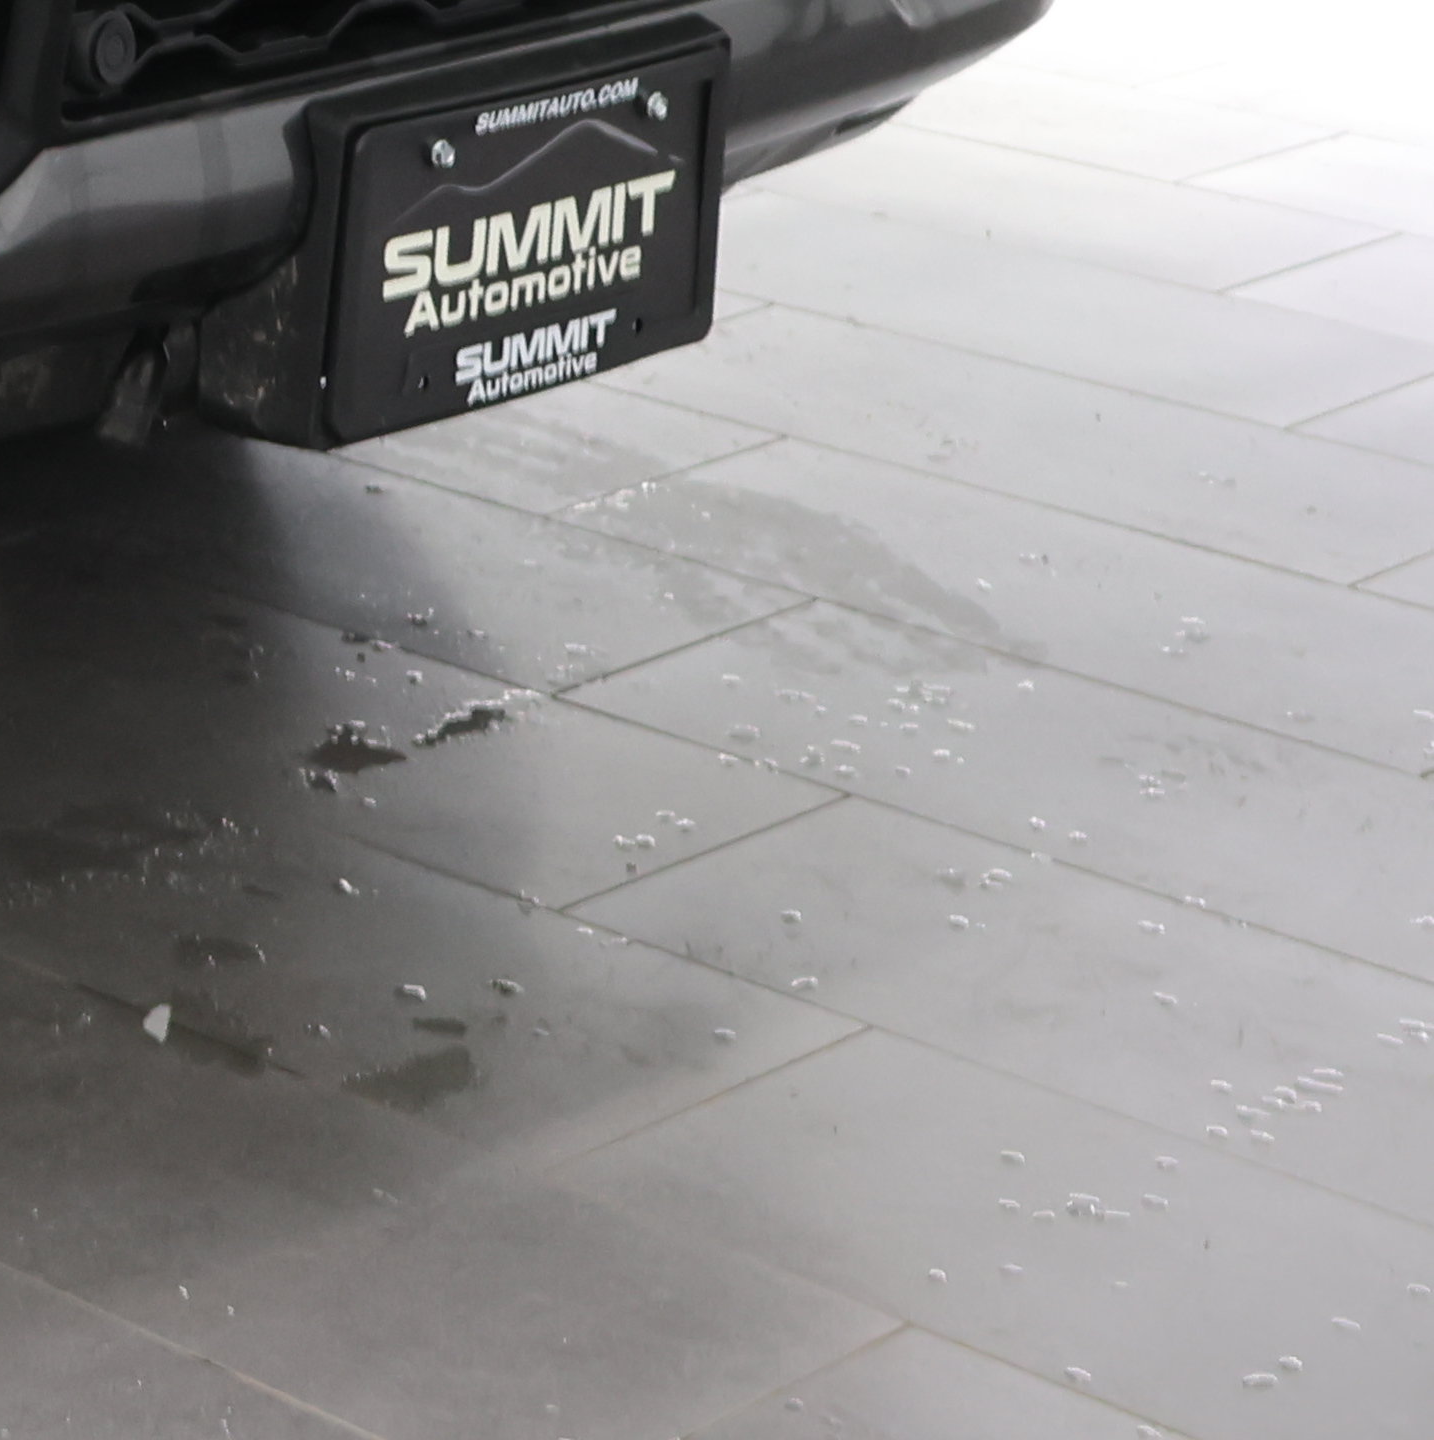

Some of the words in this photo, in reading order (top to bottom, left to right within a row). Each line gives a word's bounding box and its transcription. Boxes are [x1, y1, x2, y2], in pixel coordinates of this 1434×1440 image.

[475, 78, 639, 136] SUMMITAUTO.COM
[382, 170, 676, 303] SUMMIT
[404, 245, 642, 337] Automotive
[455, 308, 617, 387] SUMMIT
[467, 349, 598, 407] Automotive
